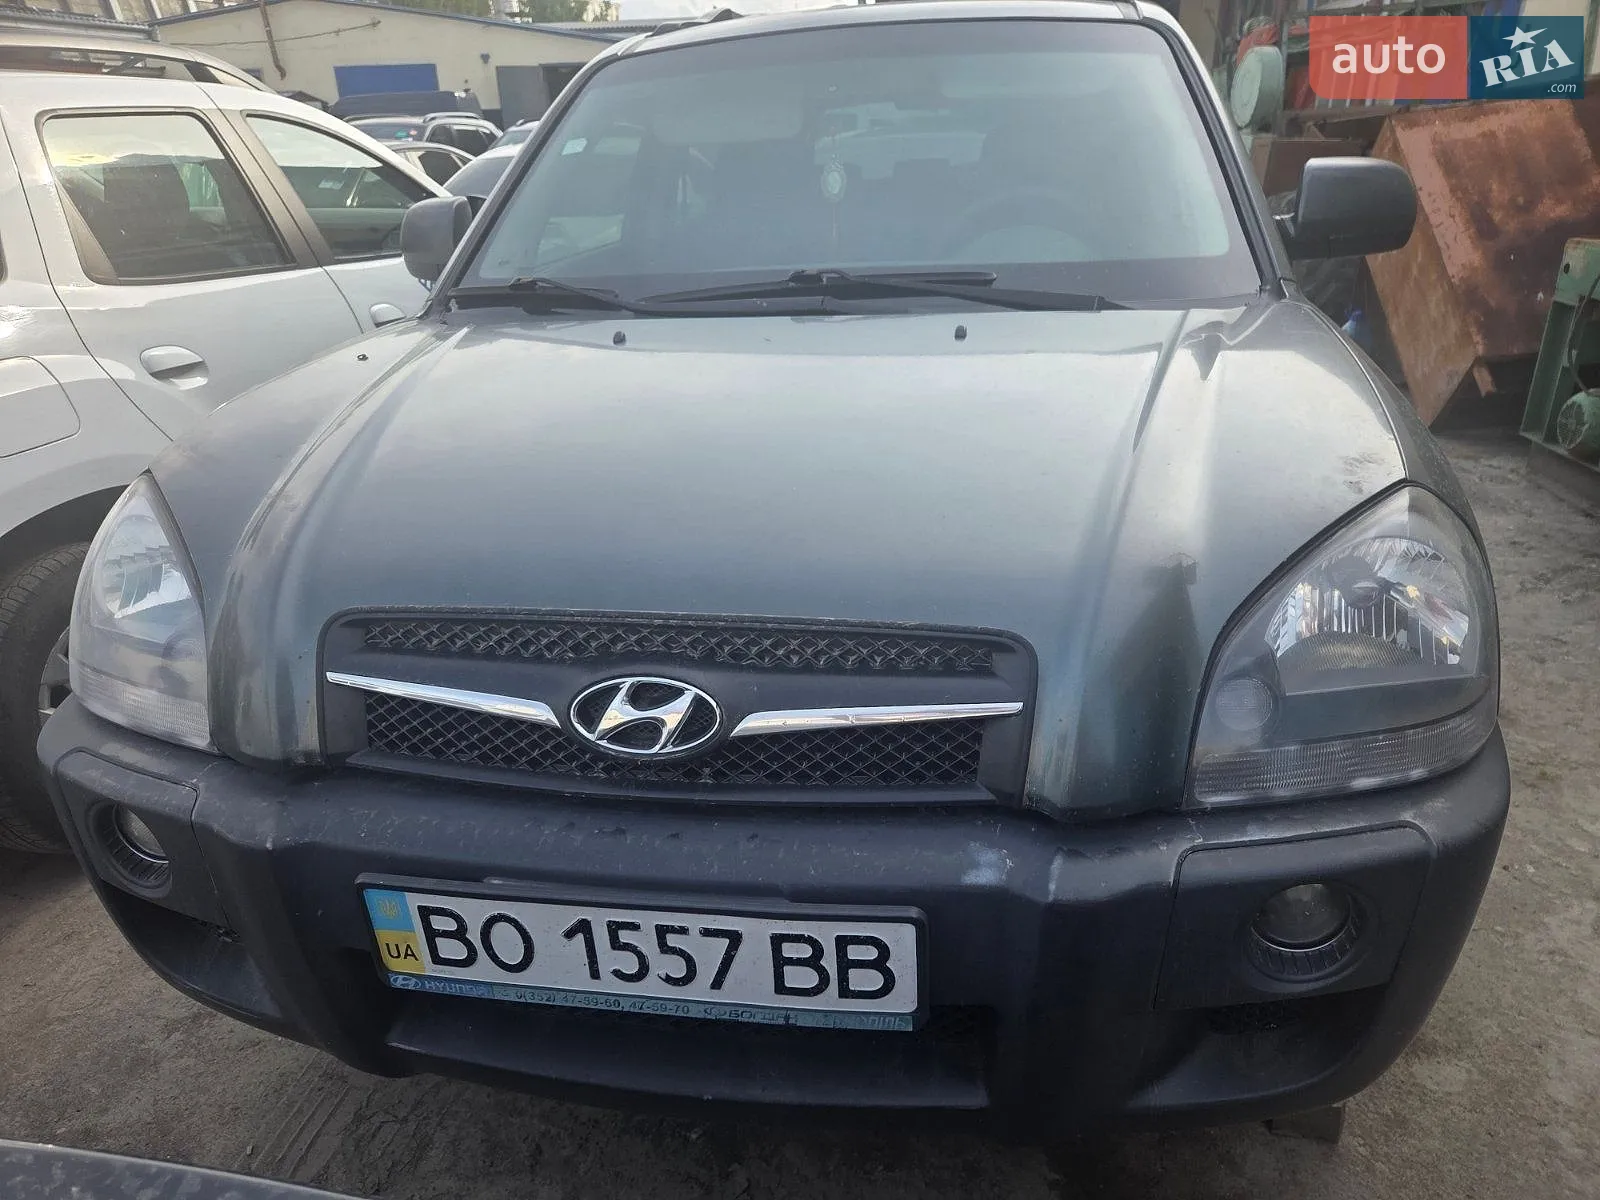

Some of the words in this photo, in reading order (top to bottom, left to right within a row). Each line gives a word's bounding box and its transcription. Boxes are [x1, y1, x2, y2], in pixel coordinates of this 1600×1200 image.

[385, 942, 419, 962] UA
[416, 904, 535, 974] BO
[561, 918, 743, 990] 1557
[769, 932, 896, 1000] BB
[424, 980, 492, 996] HYUND
